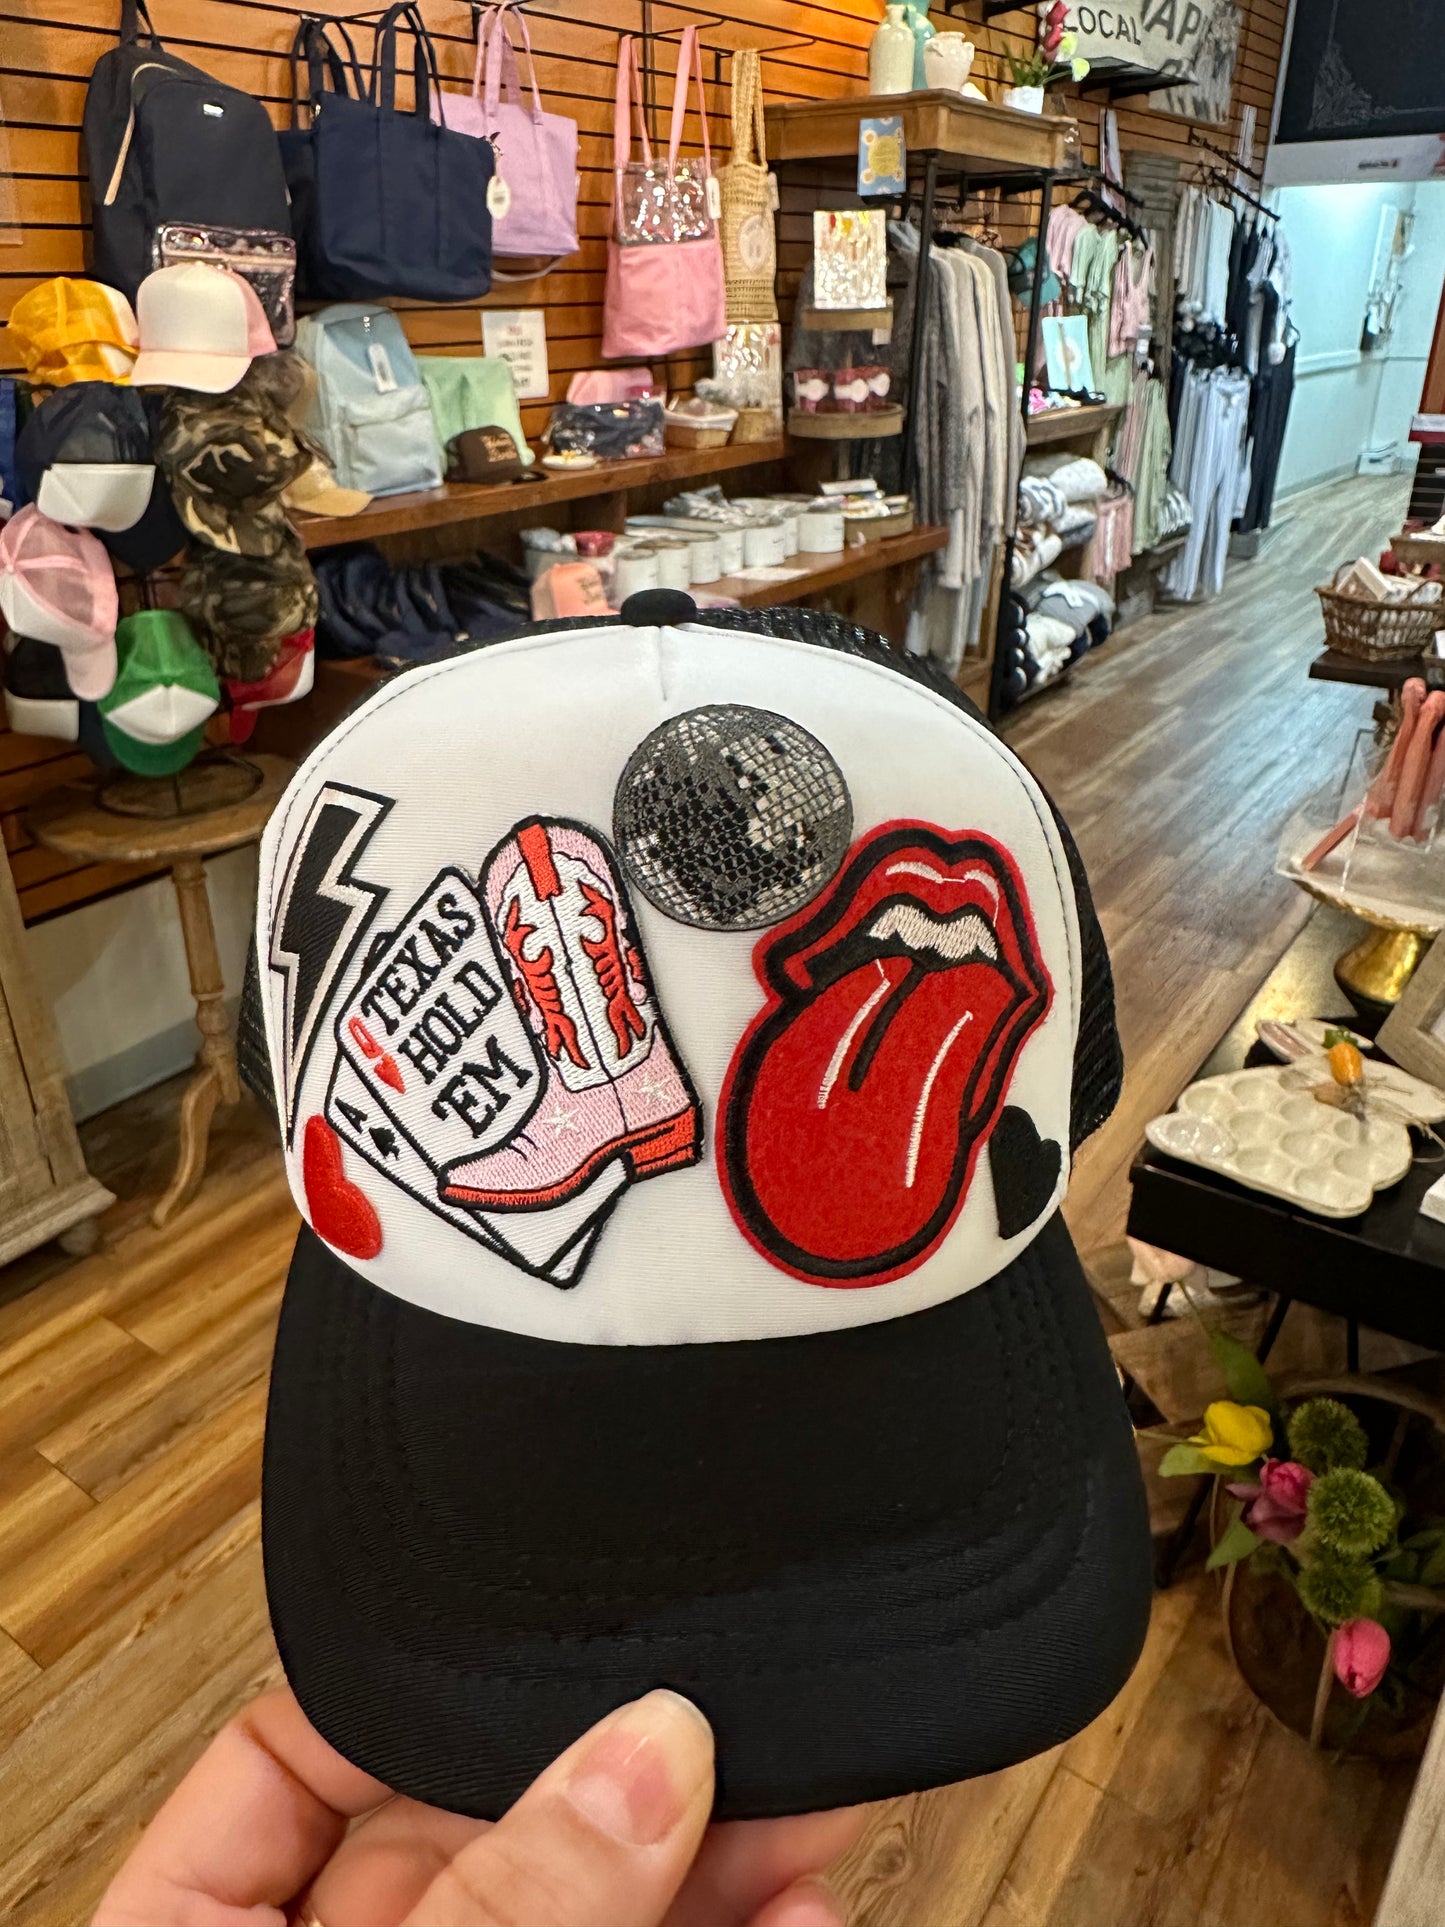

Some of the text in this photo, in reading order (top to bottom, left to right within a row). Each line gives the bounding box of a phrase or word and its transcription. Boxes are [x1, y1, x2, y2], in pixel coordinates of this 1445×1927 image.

[361, 893, 476, 1035] TEXAS
[398, 961, 503, 1084] HOLD
[335, 1097, 368, 1133] A
